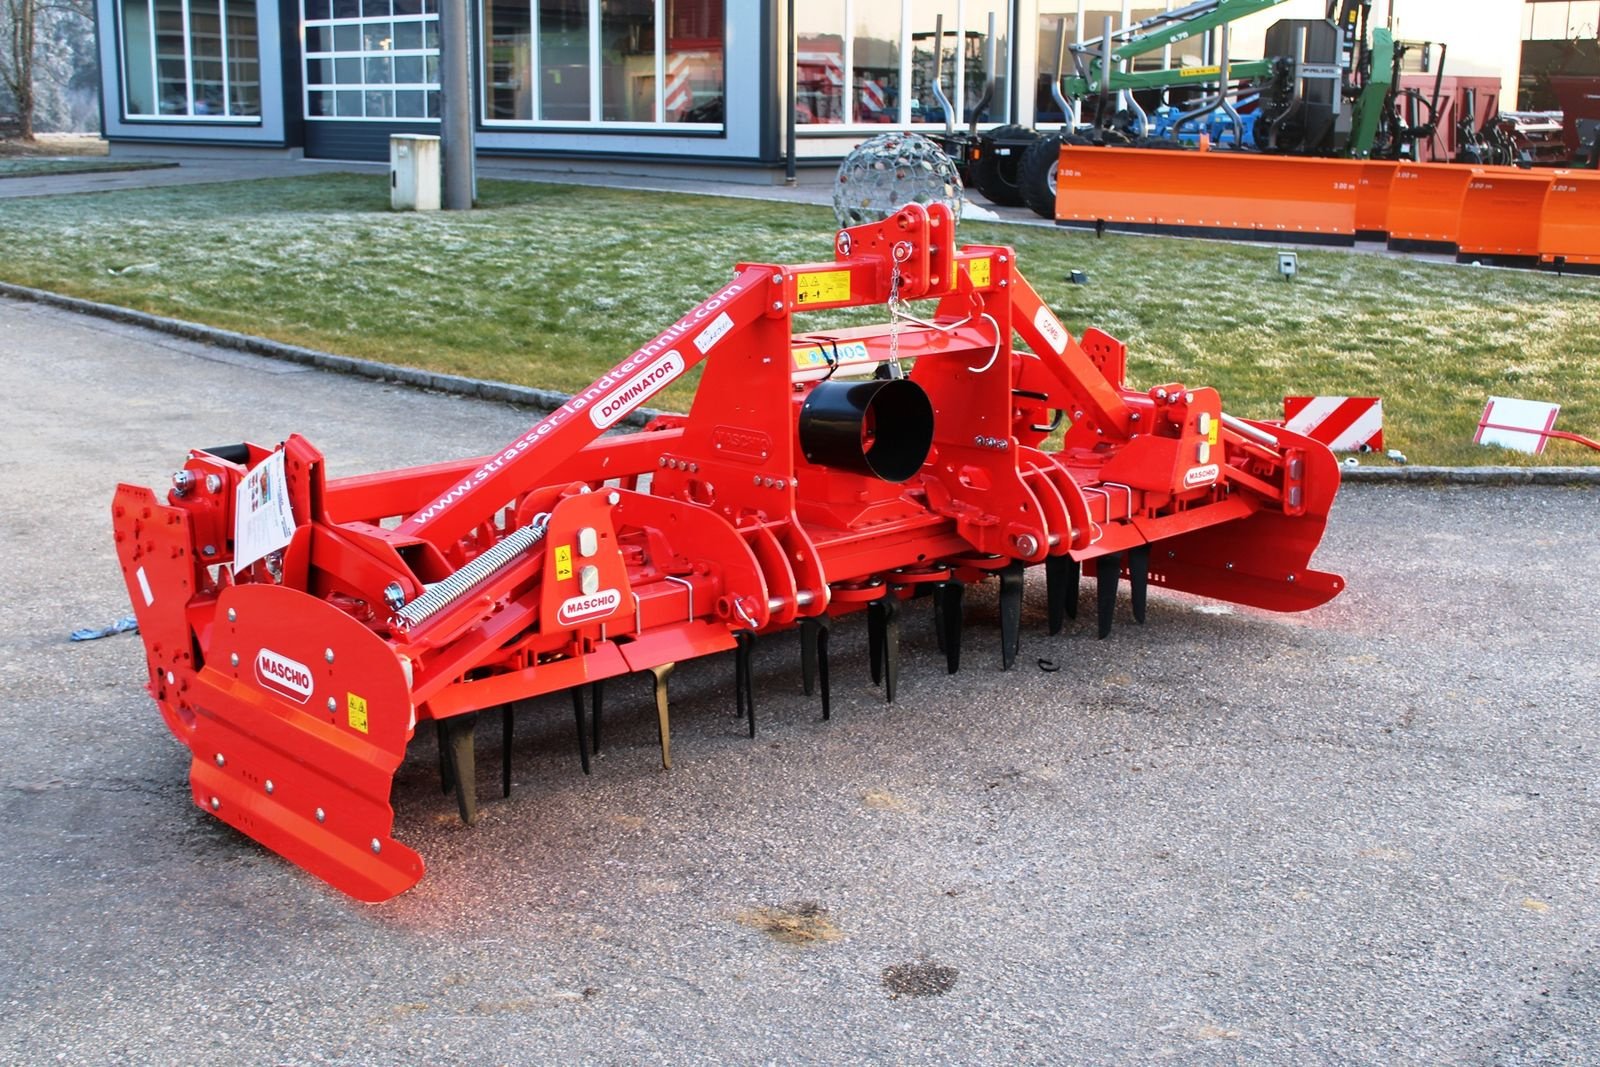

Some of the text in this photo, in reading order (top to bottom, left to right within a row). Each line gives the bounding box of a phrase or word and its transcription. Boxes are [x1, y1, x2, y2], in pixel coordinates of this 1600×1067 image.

[413, 283, 743, 524] www.strasser-landtechnik.com
[601, 361, 674, 418] DOMINATOR
[1189, 468, 1216, 479] MASCHIO
[567, 595, 615, 613] MASCHIO
[262, 656, 309, 689] MASCHIO
